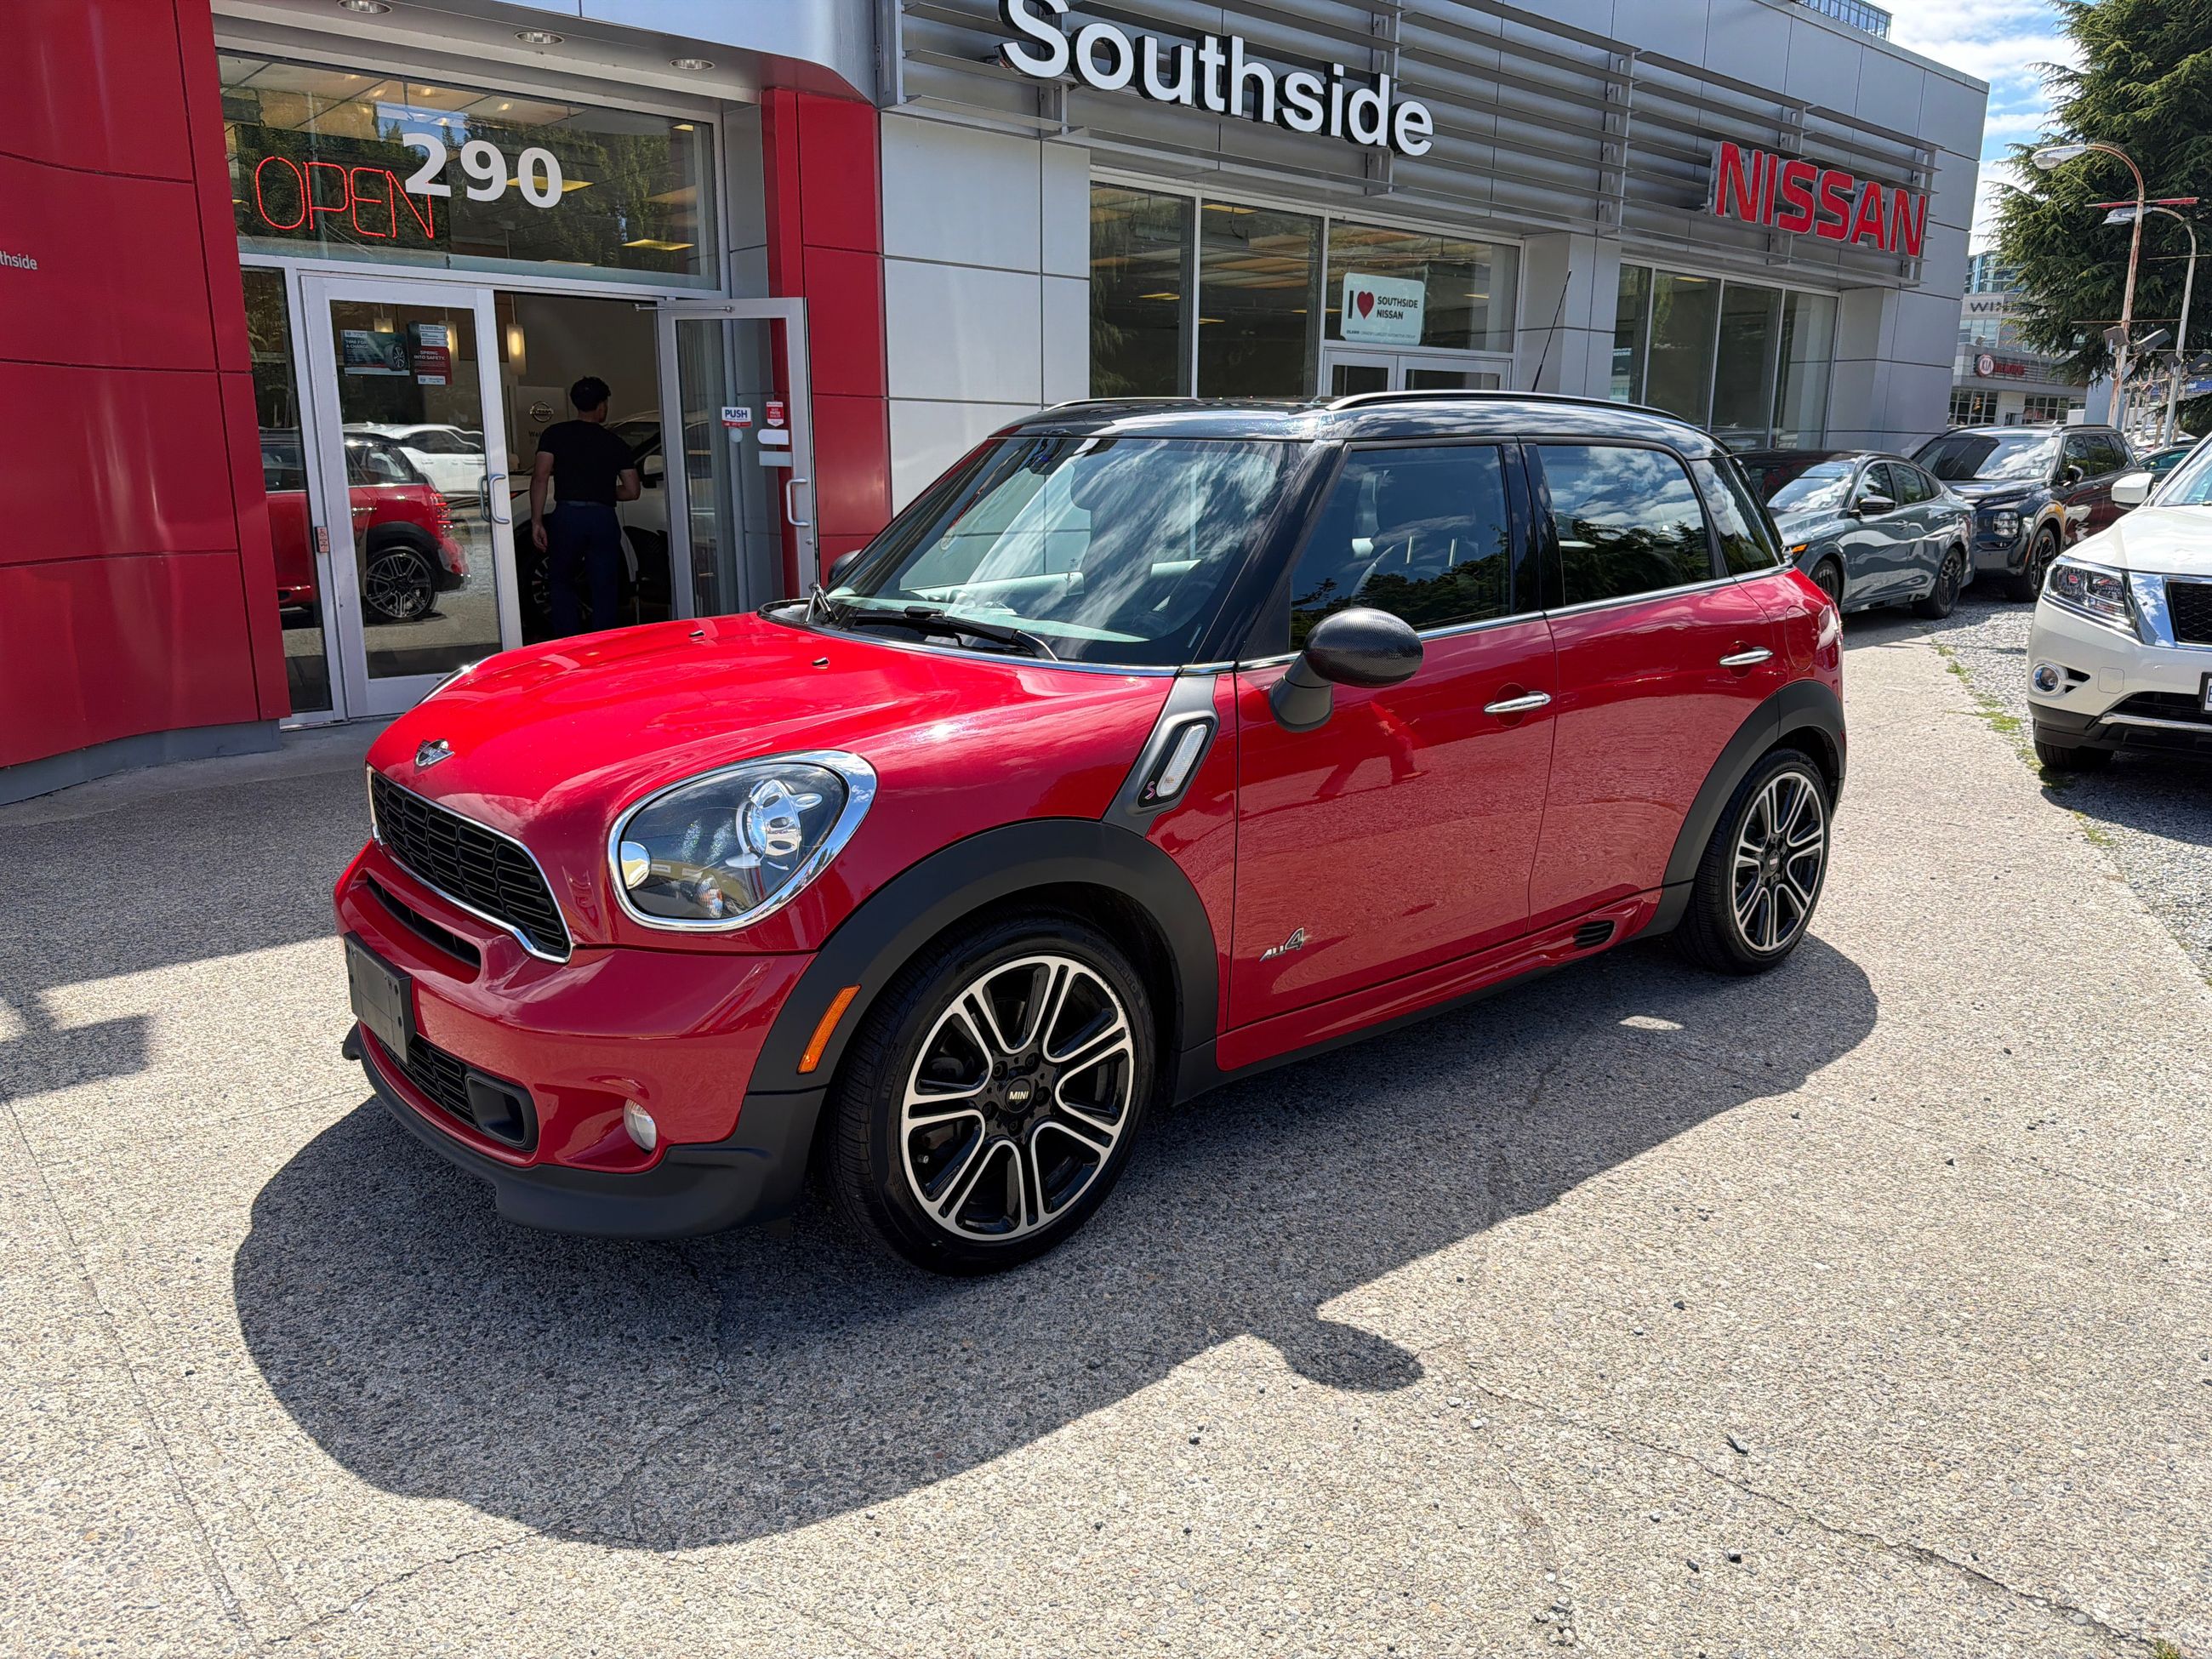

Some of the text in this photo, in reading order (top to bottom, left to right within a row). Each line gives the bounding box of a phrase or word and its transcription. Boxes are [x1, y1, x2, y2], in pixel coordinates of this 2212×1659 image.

[997, 0, 1434, 157] Southside
[402, 132, 563, 209] 290
[255, 155, 434, 240] OPEN
[1708, 140, 1928, 259] NISSAN
[1376, 310, 1404, 321] NISSAN
[1377, 295, 1419, 309] SOUTHSIDE
[725, 409, 748, 418] PUSH
[1009, 1091, 1029, 1100] MINI
